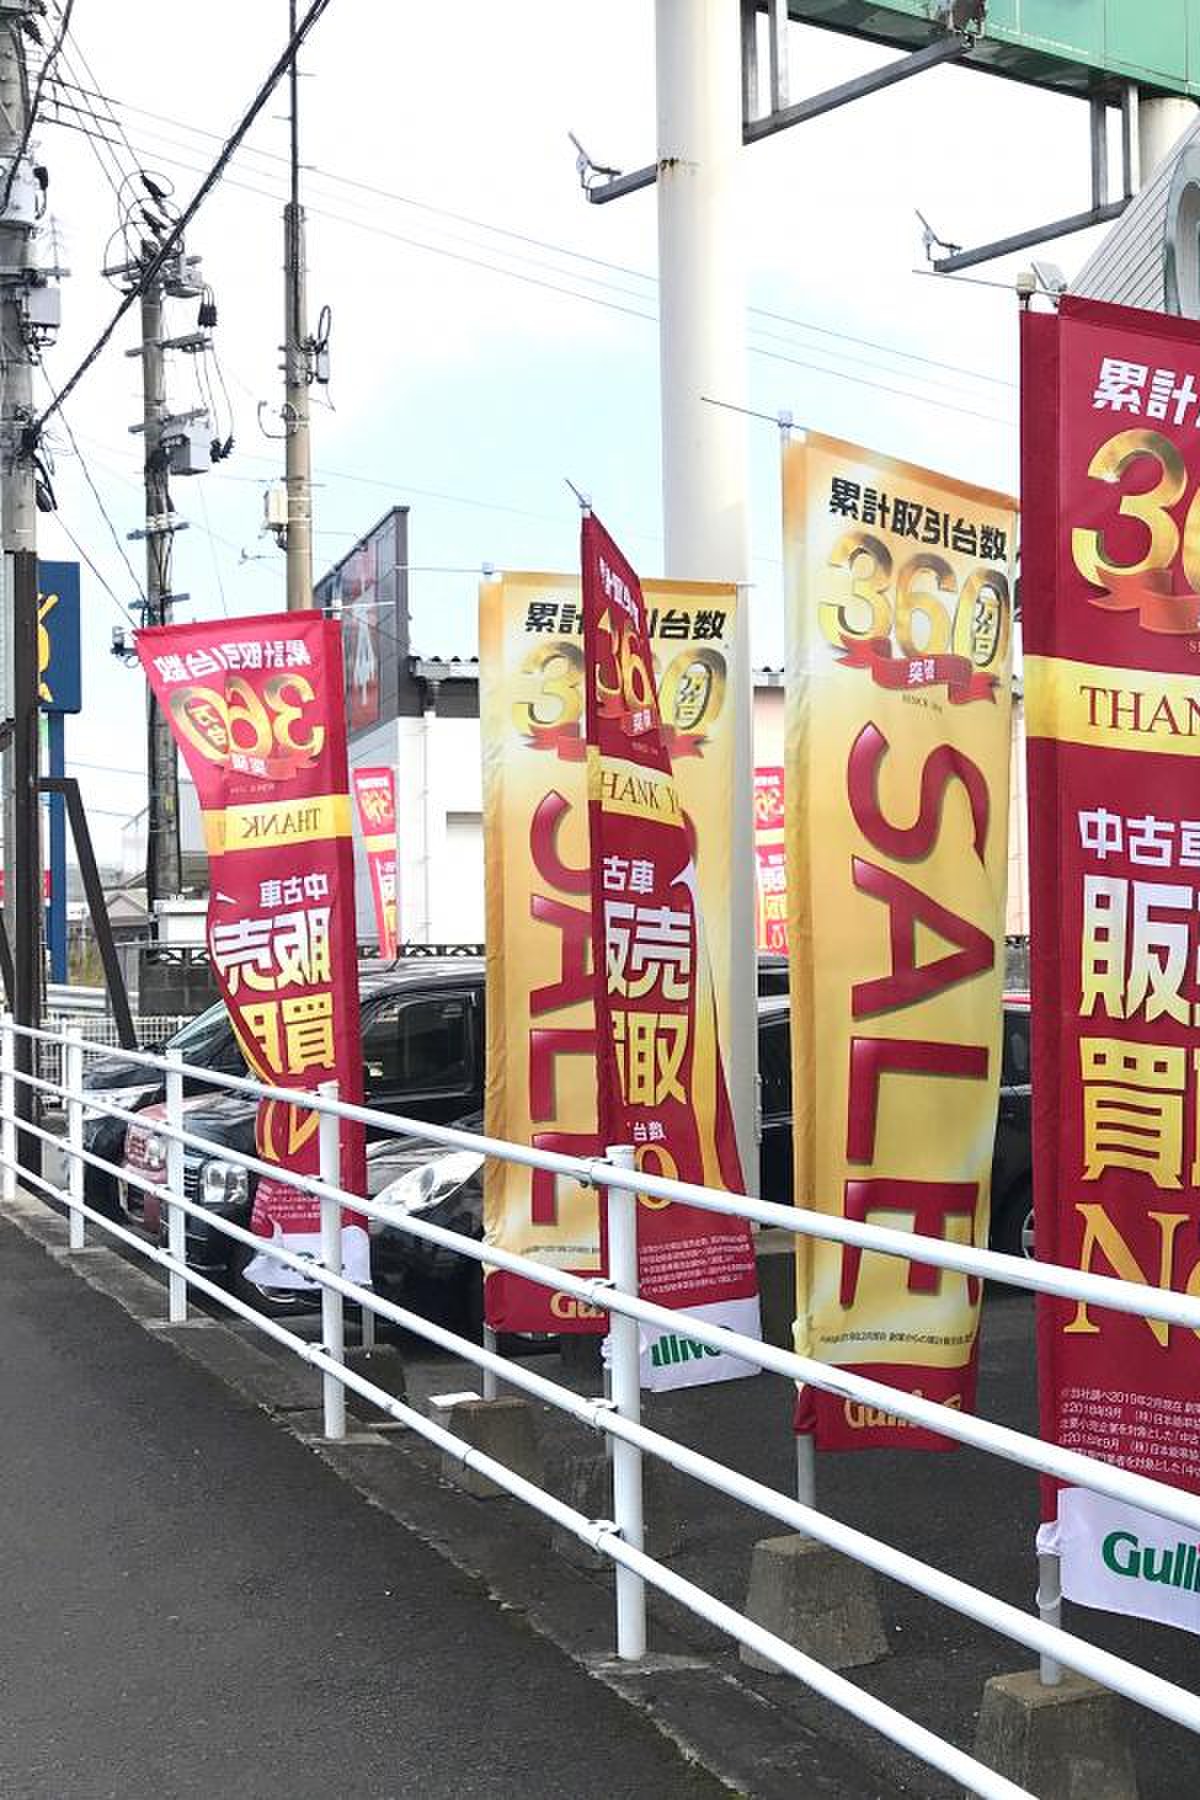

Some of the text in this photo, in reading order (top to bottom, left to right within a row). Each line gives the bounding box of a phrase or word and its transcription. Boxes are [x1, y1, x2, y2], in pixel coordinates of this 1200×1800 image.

[829, 476, 1008, 561] 累計取引台数
[525, 601, 727, 641] 累計台数
[817, 531, 1010, 672] 360
[512, 641, 728, 733] 30
[603, 855, 655, 894] 古車
[839, 719, 996, 1310] SALE
